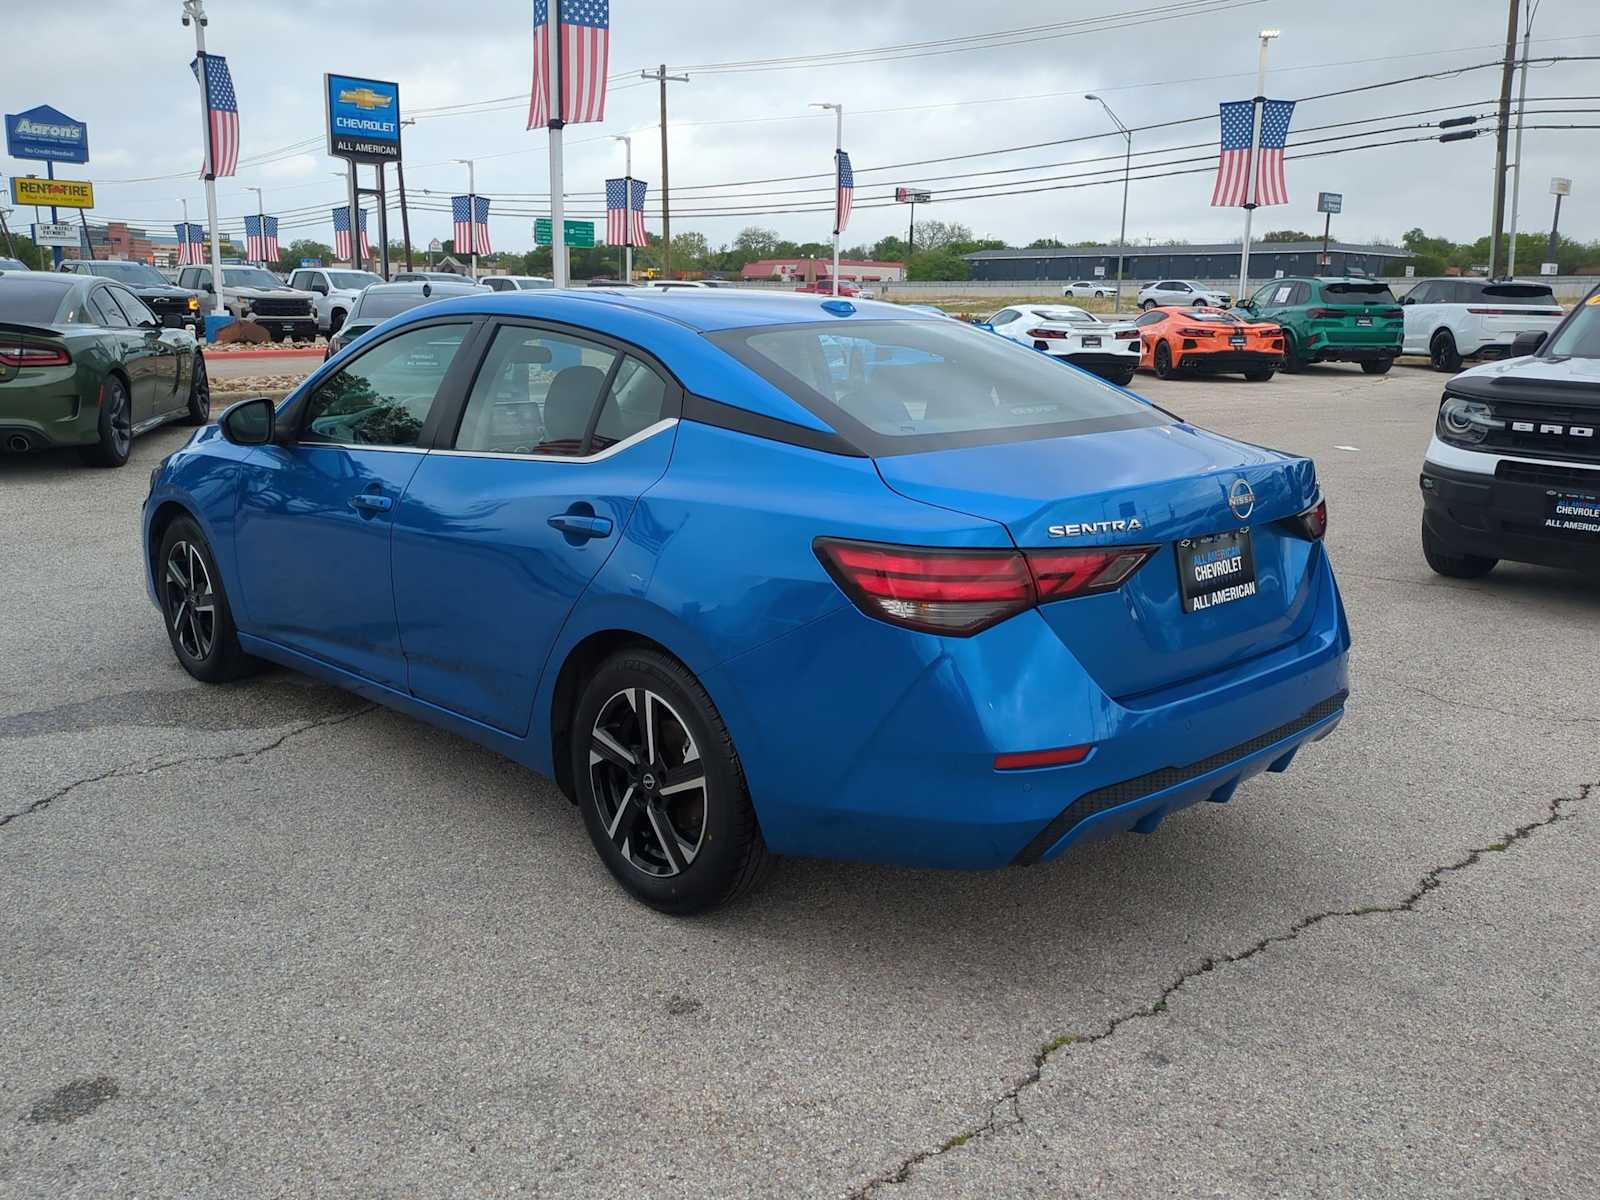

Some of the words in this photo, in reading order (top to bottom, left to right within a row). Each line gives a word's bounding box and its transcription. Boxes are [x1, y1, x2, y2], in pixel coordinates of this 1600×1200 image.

[15, 118, 82, 138] Aaron's
[336, 117, 395, 132] CHEVROLET
[338, 141, 353, 151] ALL
[355, 143, 397, 155] AMERICAN
[1048, 518, 1142, 539] SENTRA
[1545, 519, 1561, 528] ALL
[1193, 552, 1208, 565] ALL
[1208, 545, 1241, 562] AMERICAN
[1194, 556, 1242, 582] CHEVROLET
[1193, 594, 1211, 611] ALL
[1212, 581, 1256, 606] AMERICAN
